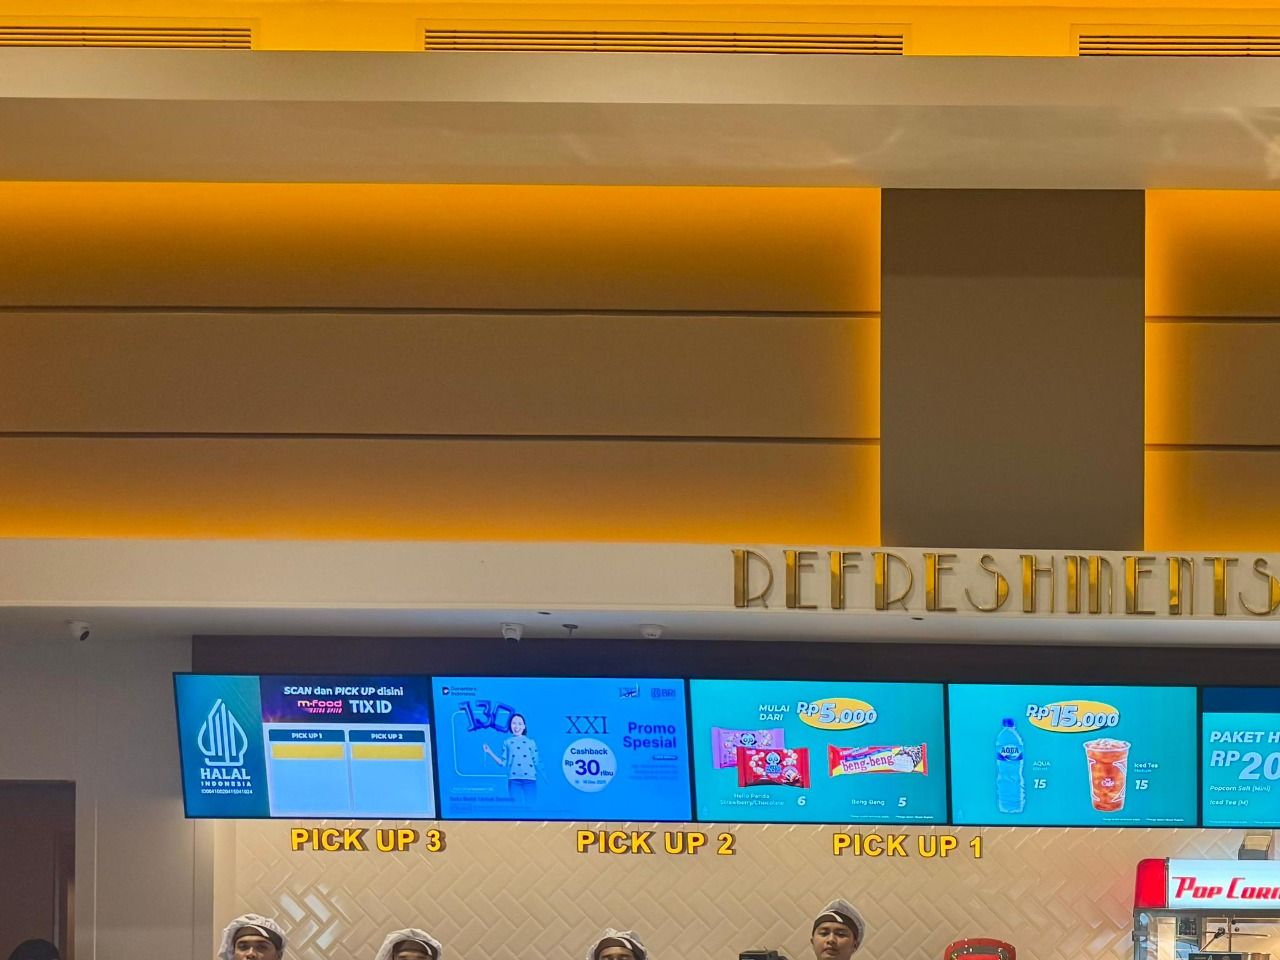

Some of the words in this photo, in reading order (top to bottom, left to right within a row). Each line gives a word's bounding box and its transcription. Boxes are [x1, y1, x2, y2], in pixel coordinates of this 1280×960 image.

[284, 687, 312, 696] SCAN
[314, 687, 333, 696] dan
[335, 687, 359, 696] PICK
[361, 687, 375, 696] UP
[377, 687, 404, 696] disini
[349, 700, 372, 714] TIX
[377, 700, 392, 714] ID
[759, 704, 790, 713] MULAI
[797, 702, 877, 724] Rp5.000
[1026, 704, 1120, 727] Rp15.000
[565, 716, 610, 734] XXI
[628, 722, 676, 734] Promo
[1210, 731, 1264, 743] PAKET
[623, 736, 677, 751] Spesial
[570, 747, 608, 755] Cashback
[565, 760, 574, 768] Rp
[575, 760, 600, 776] 30
[600, 769, 614, 777] ribu
[842, 754, 894, 772] beng-beng
[201, 769, 251, 780] HALAL
[1034, 779, 1047, 789] 15
[1135, 780, 1148, 790] 15
[1210, 785, 1237, 793] Popcorn
[797, 796, 806, 806] 6
[898, 797, 906, 807] 5
[291, 828, 364, 851] PICK
[377, 829, 415, 852] UP
[426, 830, 441, 852] 3
[577, 830, 652, 854] PICK
[665, 832, 705, 854] UP
[718, 833, 734, 855] 2
[833, 833, 907, 856] PICK
[918, 834, 957, 858] UP
[970, 836, 982, 858] 1
